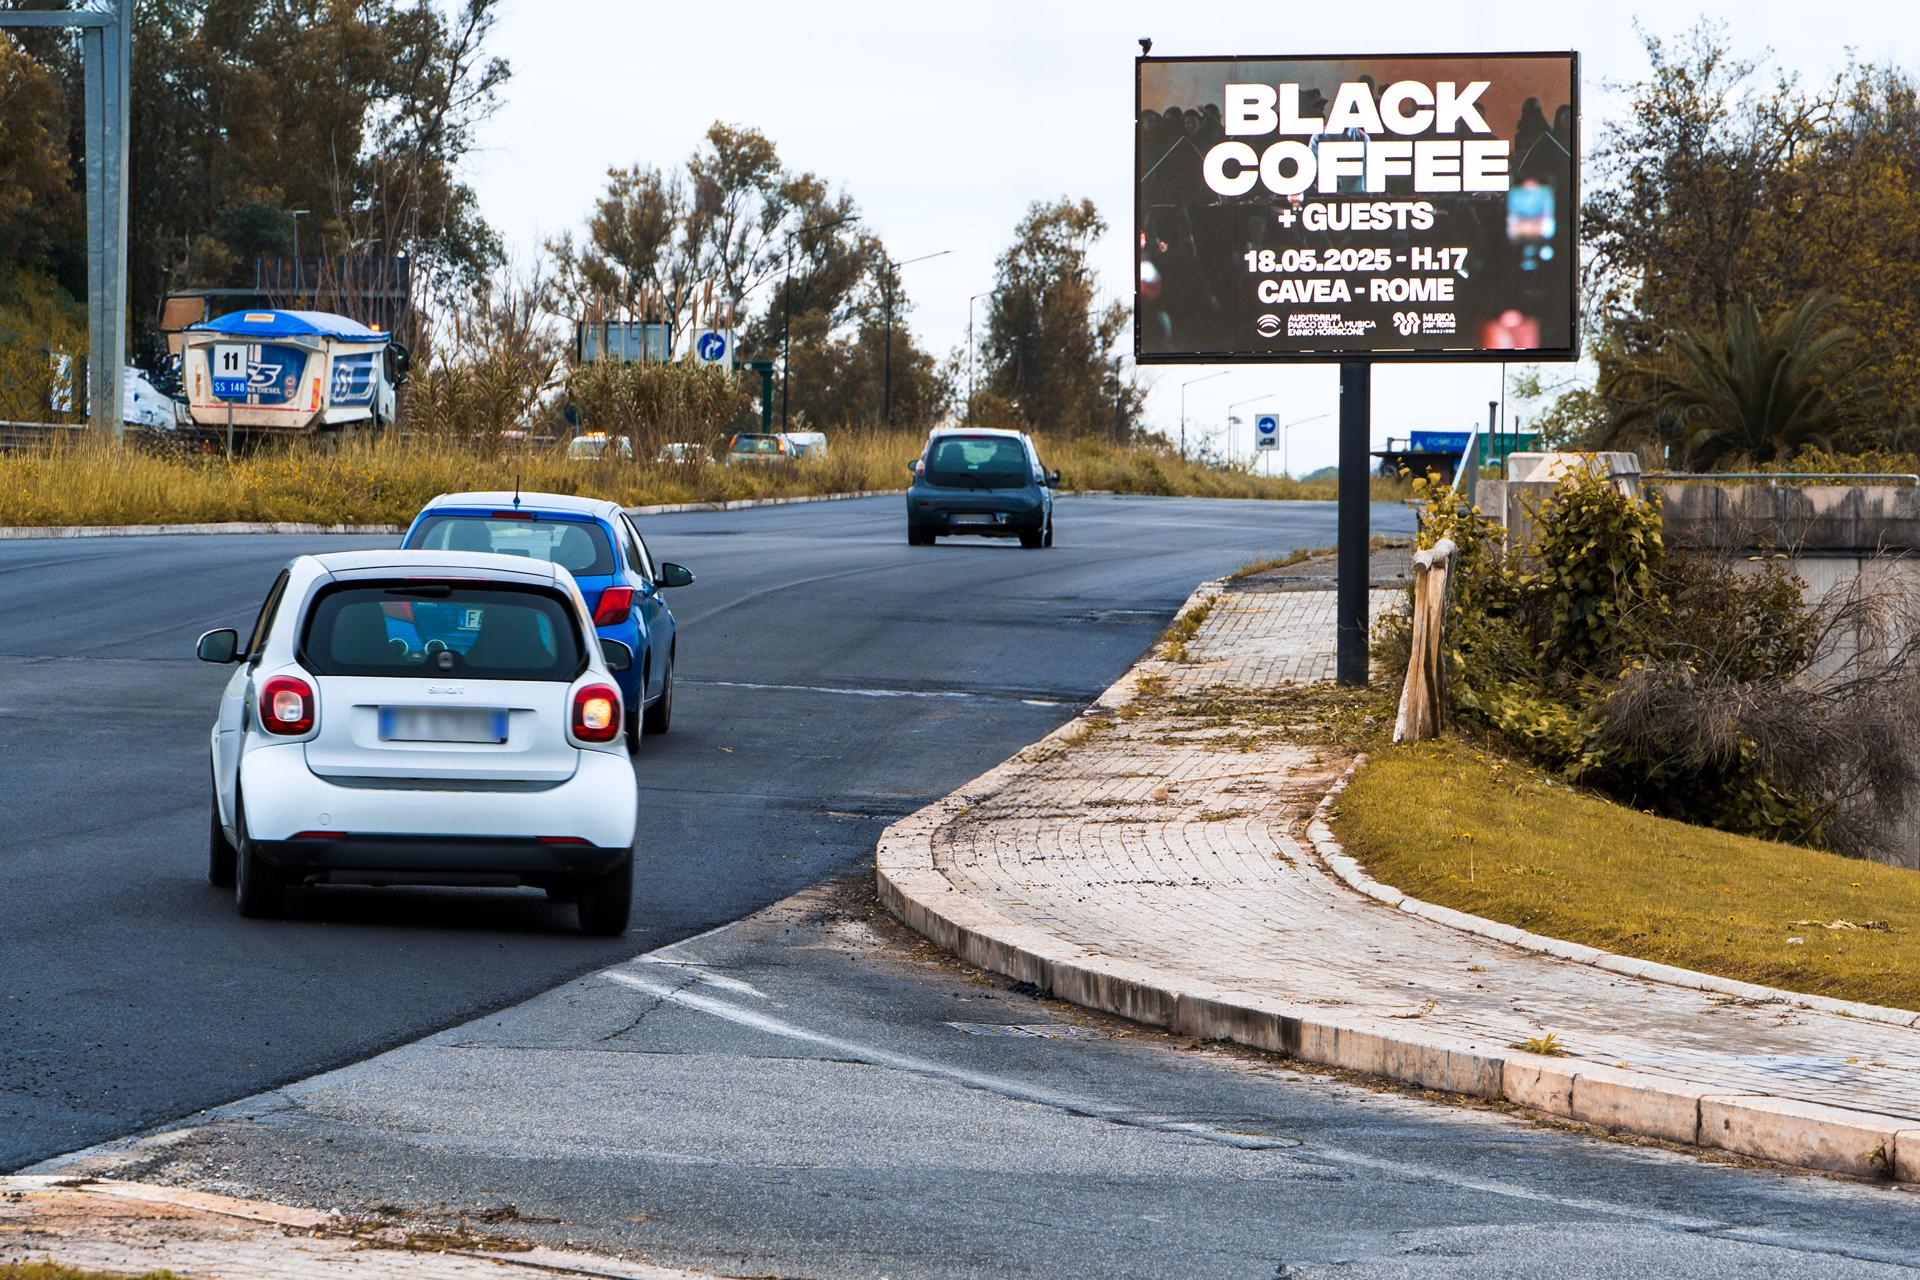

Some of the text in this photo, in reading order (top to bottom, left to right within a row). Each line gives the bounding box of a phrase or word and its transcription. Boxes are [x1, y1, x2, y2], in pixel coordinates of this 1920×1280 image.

[1225, 80, 1492, 136] BLACK
[1203, 140, 1510, 196] COFFEE
[1278, 201, 1435, 231] + GUESTS
[1244, 246, 1469, 273] 18.05.2025 - H.17
[1257, 279, 1352, 304] CAVEA
[1370, 278, 1455, 302] ROME
[1287, 313, 1341, 322] AUDITORIUM
[1287, 320, 1376, 329] PARCO DELLA MUSICA
[1422, 312, 1456, 321] MUSICA
[1287, 328, 1364, 337] ENNIO MORRICONE
[223, 351, 239, 370] 11
[214, 382, 245, 392] SS 148
